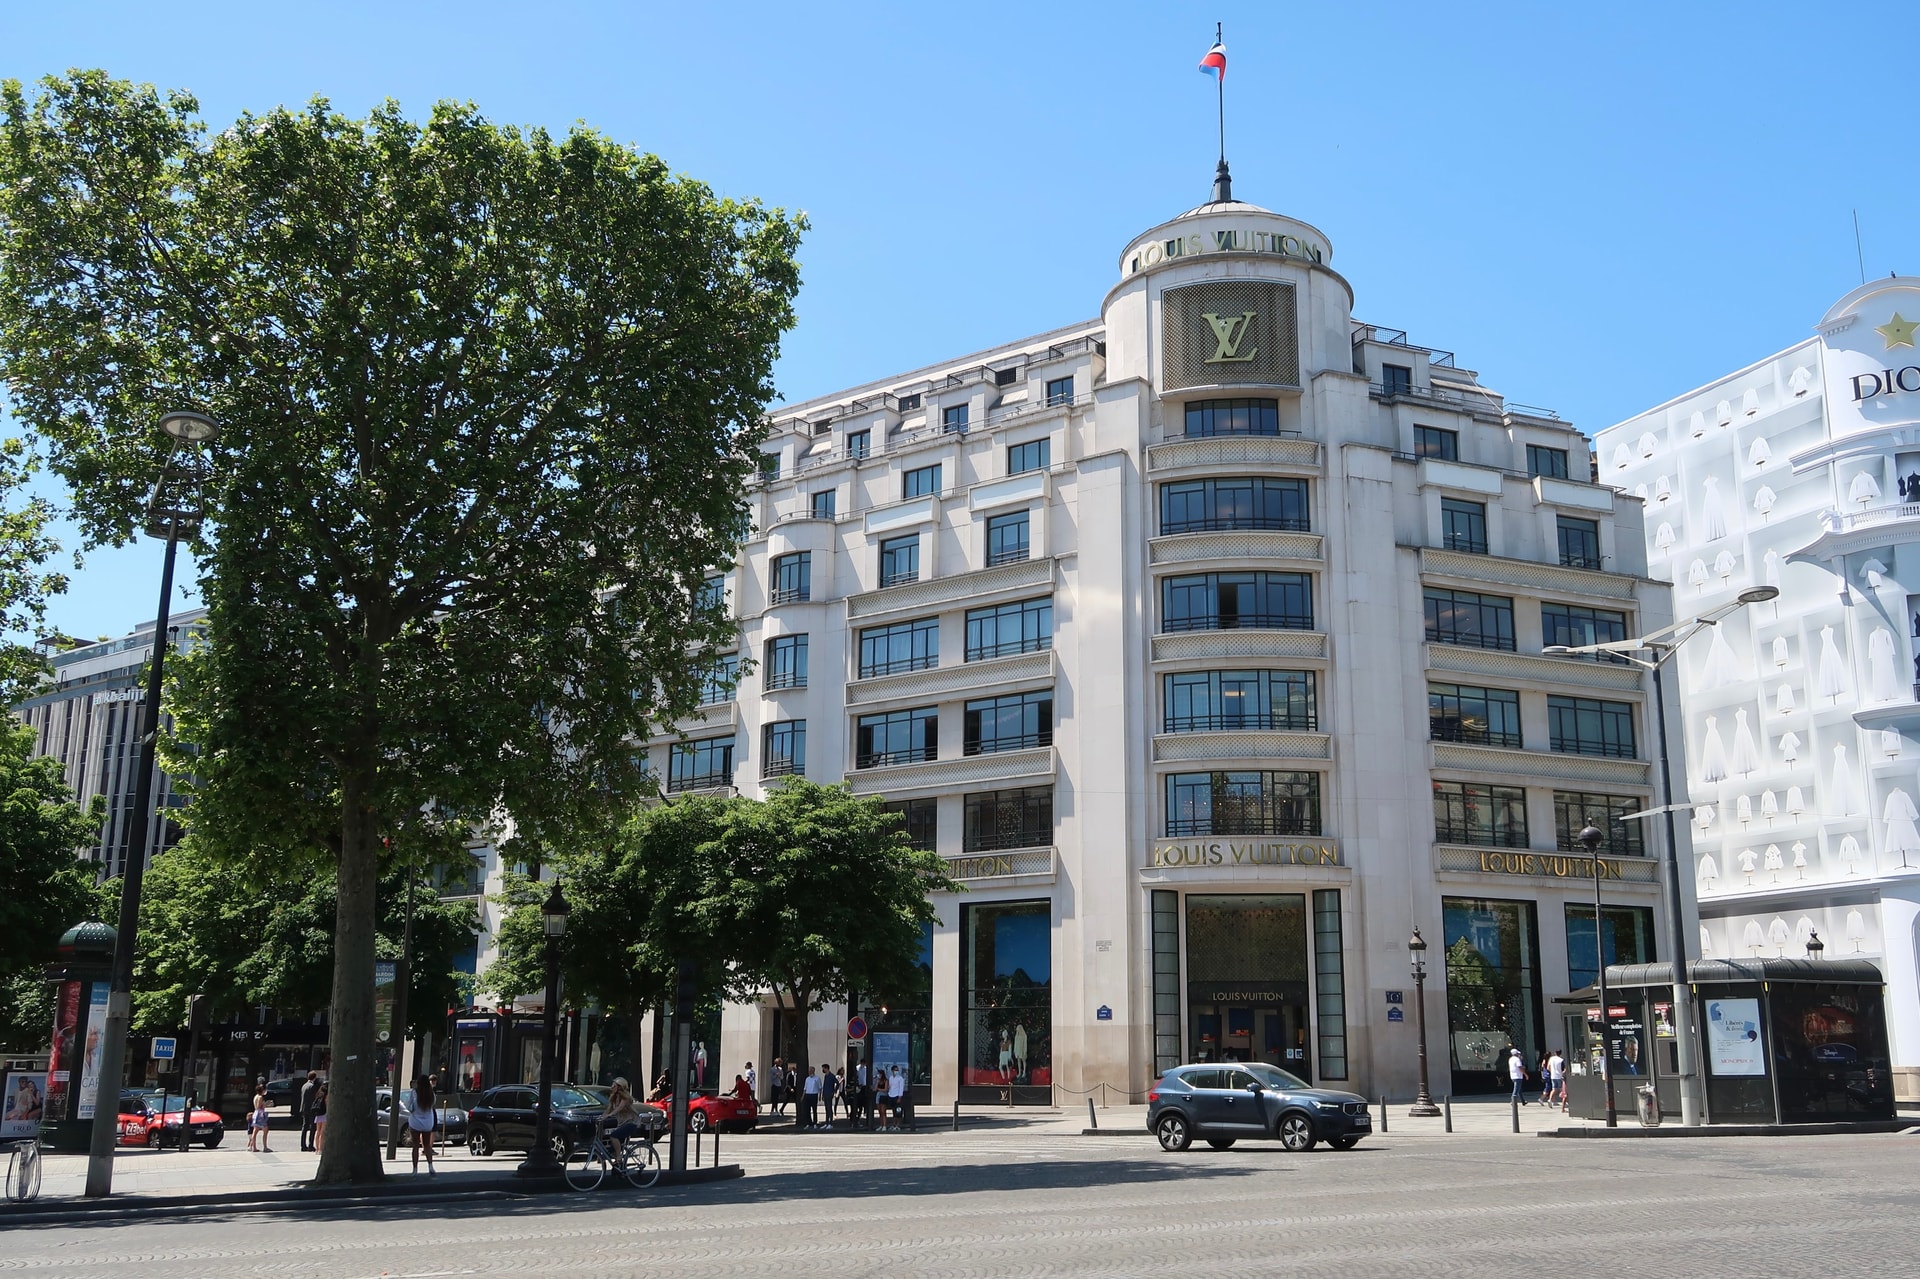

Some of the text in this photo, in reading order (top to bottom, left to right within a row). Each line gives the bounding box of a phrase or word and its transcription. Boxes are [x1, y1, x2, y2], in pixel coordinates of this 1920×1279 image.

[1136, 230, 1319, 271] LOUIS VUITTON
[1155, 843, 1337, 867] LOUIS VUITTON
[1480, 852, 1622, 880] LOUIS VUITTON
[944, 856, 1012, 879] UITTON
[1212, 992, 1284, 1001] LOUIS VUITTON
[156, 1044, 174, 1052] TAXIS
